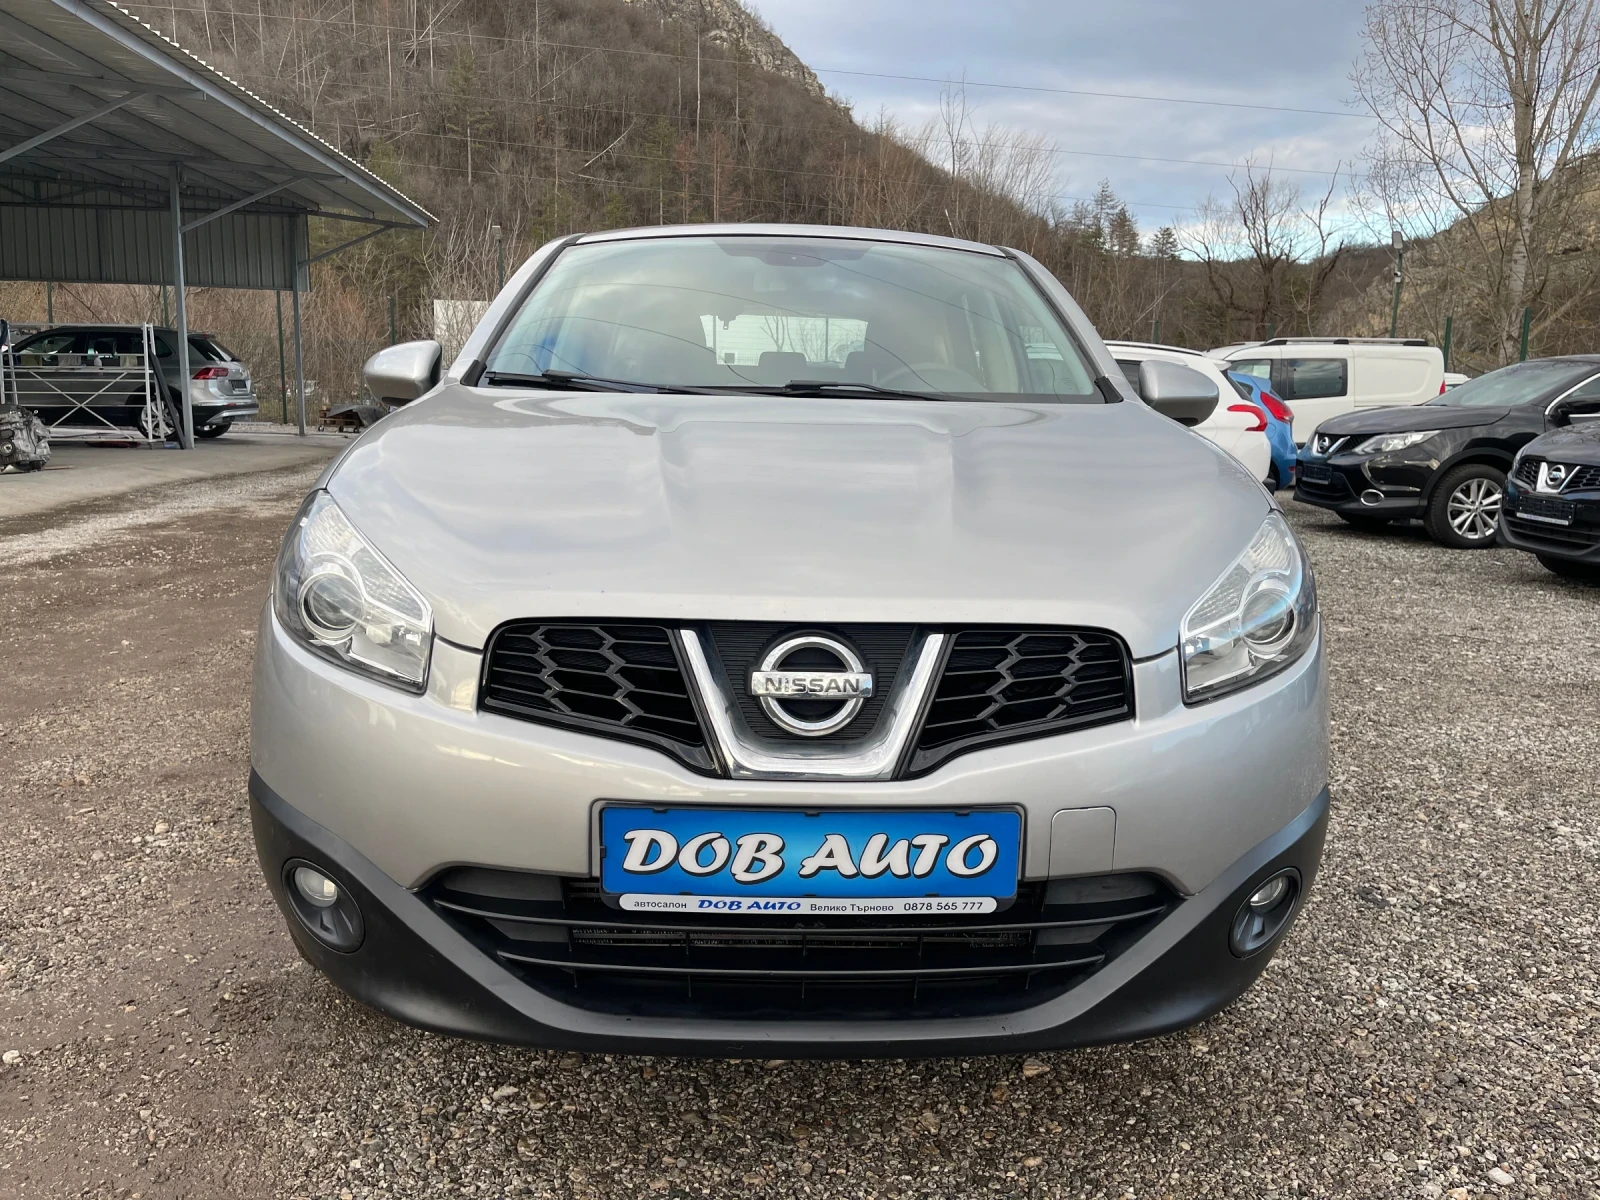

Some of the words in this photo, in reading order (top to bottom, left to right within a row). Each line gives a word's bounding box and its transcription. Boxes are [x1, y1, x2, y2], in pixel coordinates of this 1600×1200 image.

[764, 677, 860, 693] NISSAN
[623, 829, 785, 885] DOB
[798, 833, 999, 880] AUTO
[633, 900, 687, 909] автосалон
[697, 899, 742, 911] DOB
[746, 901, 802, 911] AUTO
[810, 903, 848, 912] Велико
[851, 903, 894, 913] Търново
[903, 902, 933, 911] 0878
[936, 902, 958, 911] 565
[962, 901, 984, 910] 777
